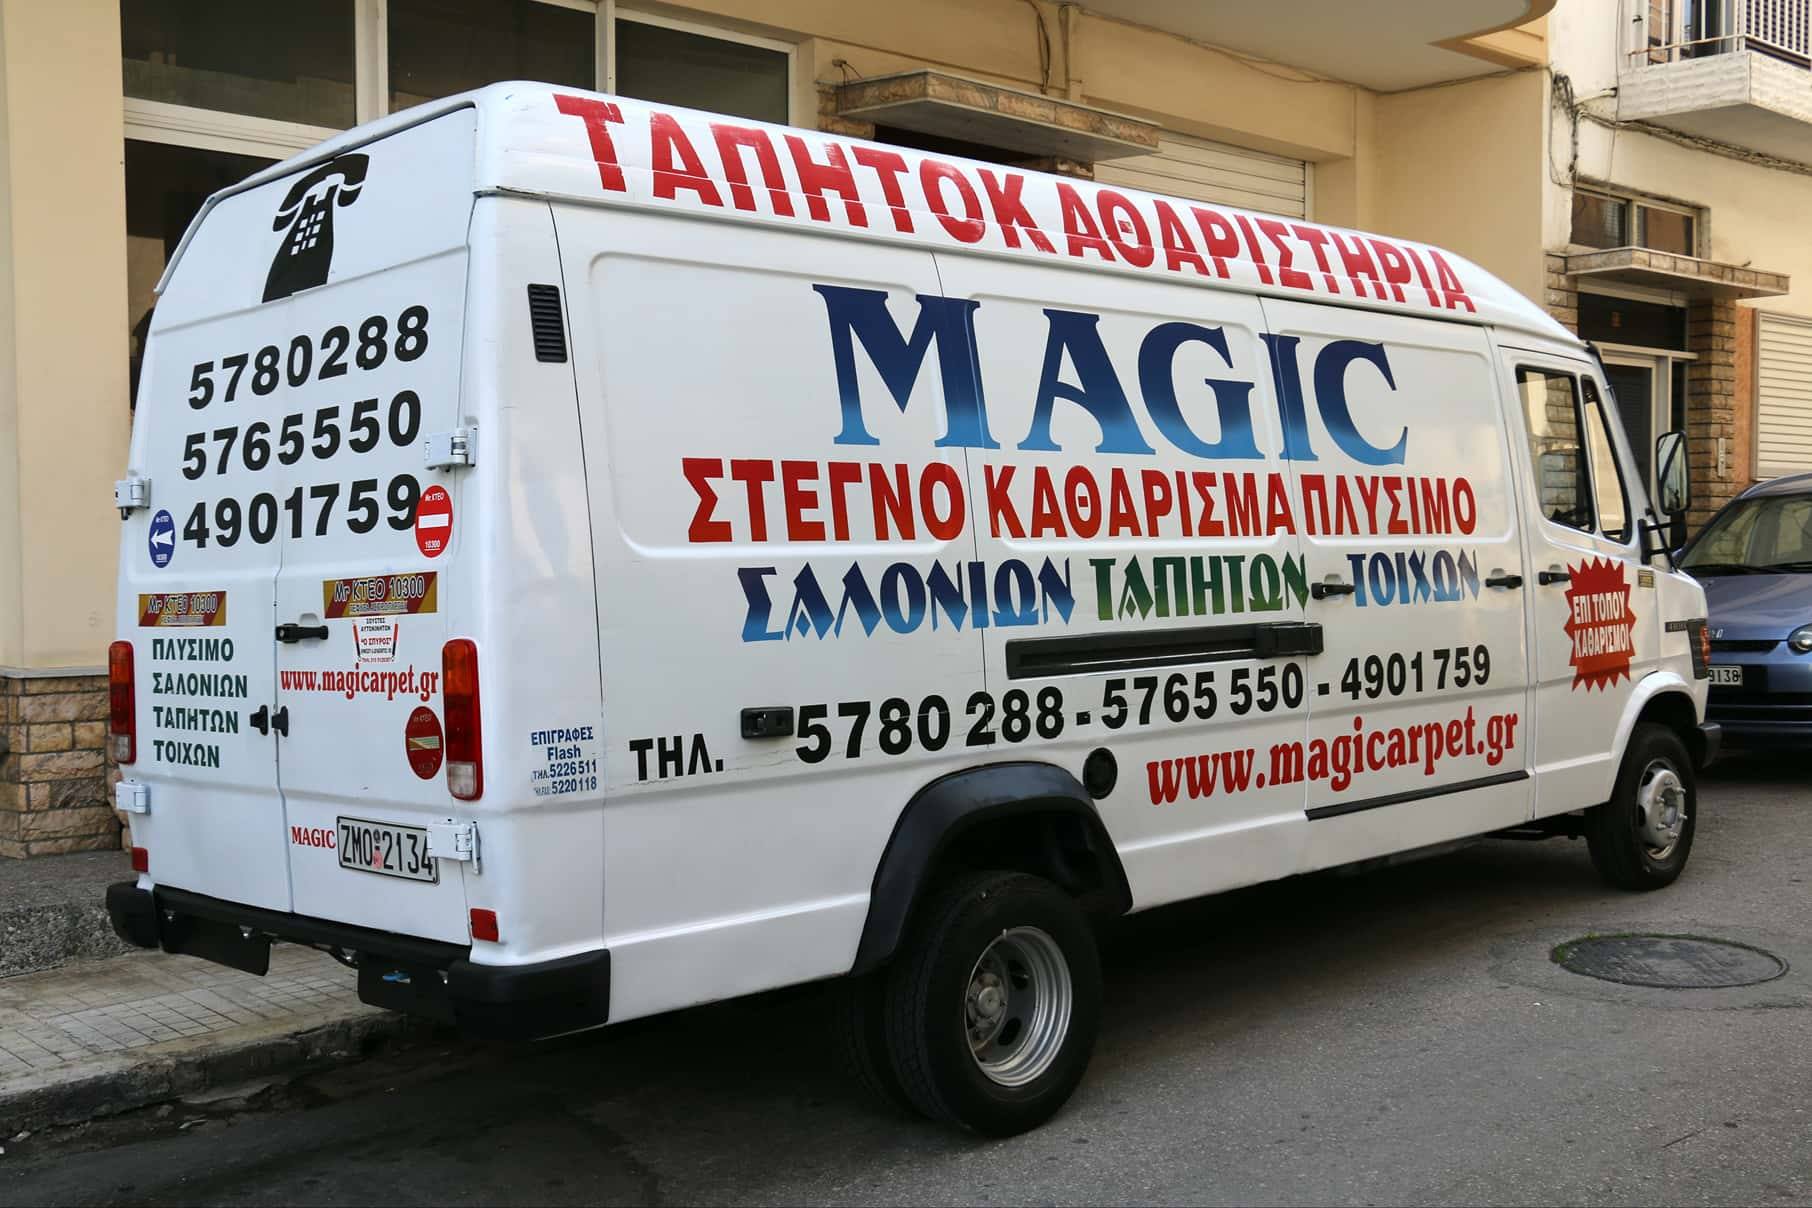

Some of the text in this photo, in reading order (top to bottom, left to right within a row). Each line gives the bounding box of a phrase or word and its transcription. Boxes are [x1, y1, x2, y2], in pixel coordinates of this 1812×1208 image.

[188, 305, 430, 410] 5780288
[812, 284, 1408, 466] MAGIC
[182, 390, 422, 481] 5765550
[183, 473, 422, 549] 4901759
[682, 457, 1477, 543] ΣΤΕΓΝΟ ΚΑΘΑΡΙΣΜΑ ΠΛΥΣΙΜΟ
[191, 593, 218, 614] 10300
[335, 580, 351, 602] Mr
[389, 575, 425, 600] 10300
[737, 548, 1481, 643] ΣΑΛΟΝΙΩΝ ΤΑΠΗΤΩΝ ΤΟΙΧΩΝ
[1573, 591, 1625, 625] ΕΠΙ ΤΟΠΟΥ
[152, 638, 234, 662] ΠΛΥΣΙΜΟ
[152, 671, 248, 698] ΣΑΛΟΝΙΩΝ
[281, 661, 439, 702] www.magicarpet.gr
[153, 705, 239, 734] ΤΑΠΗΤΩΝ
[531, 726, 594, 746] ΕΠΙΓΡΑΦΕΣ
[153, 739, 220, 768] ΤΟΙΧΩΝ
[547, 744, 581, 761] Flash
[629, 732, 725, 782] ΤΗΛ.
[1146, 705, 1518, 806] www.magicarpet.gr
[291, 825, 337, 849] MAGIC
